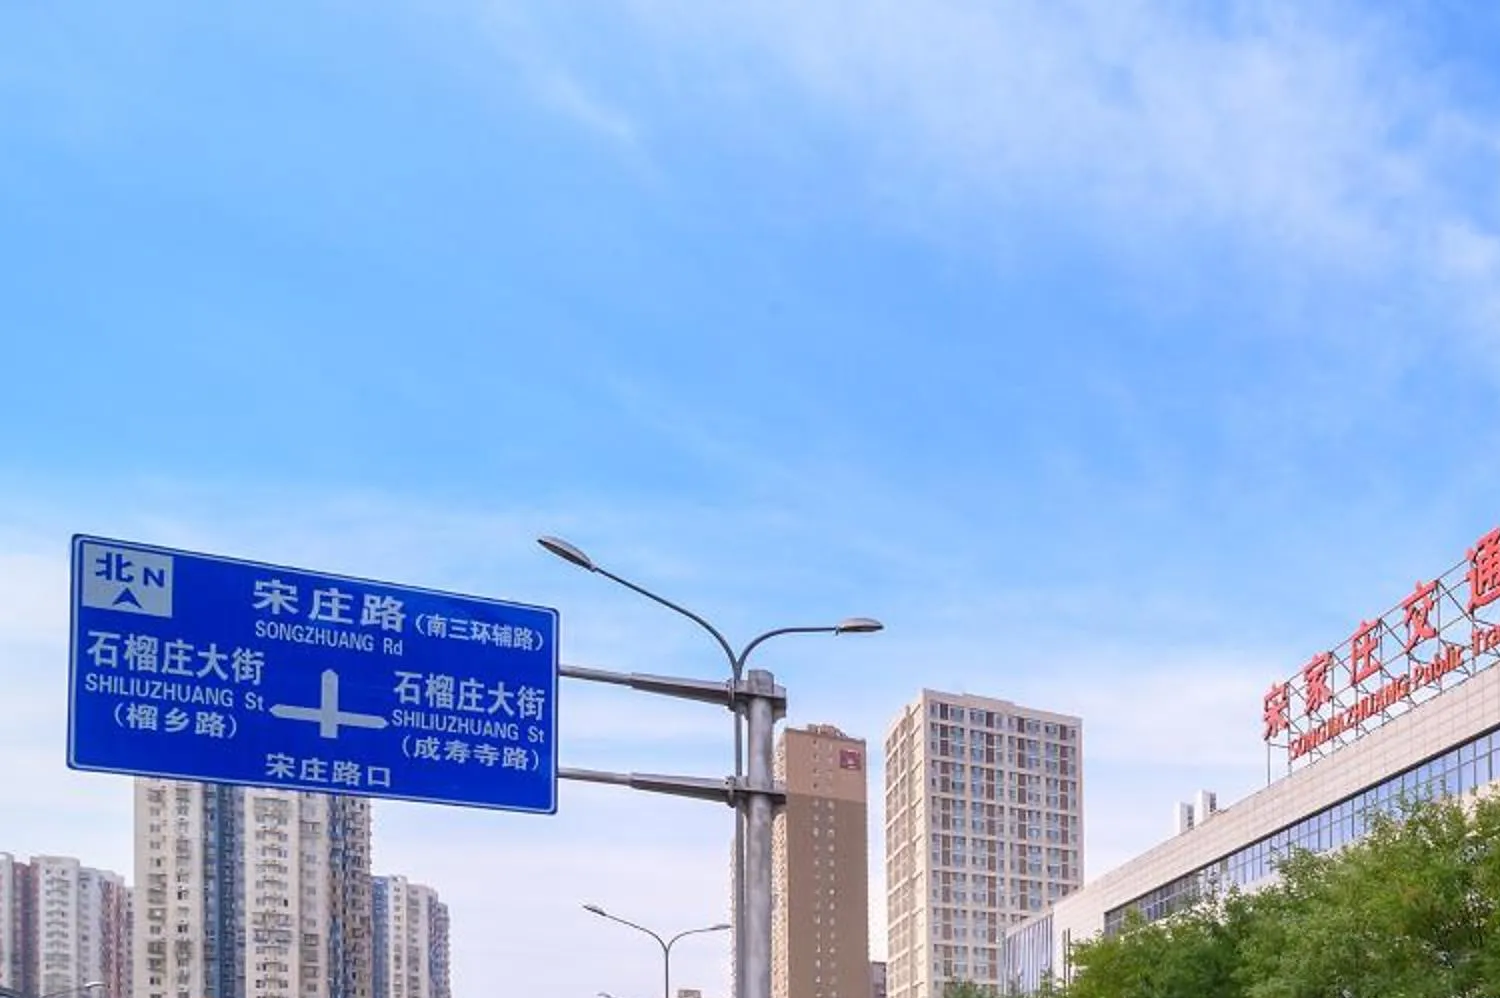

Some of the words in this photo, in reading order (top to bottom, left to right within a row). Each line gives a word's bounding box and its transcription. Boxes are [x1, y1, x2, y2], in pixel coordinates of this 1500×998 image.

[95, 552, 135, 583] 北
[143, 566, 166, 589] N
[252, 579, 406, 633] 宋庄路
[255, 620, 375, 653] SONGZHUANG
[383, 638, 404, 656] Rd
[87, 629, 266, 687] 石榴庄大街
[1413, 645, 1465, 690] Public
[84, 672, 234, 709] SHILIUZHUANG
[244, 690, 265, 713] St
[393, 669, 546, 721] 石榴庄大街
[113, 702, 238, 740] （榴乡路）
[391, 709, 520, 742] SHILIUZHUANG
[527, 724, 545, 744] St
[264, 752, 393, 788] 宋庄路口
